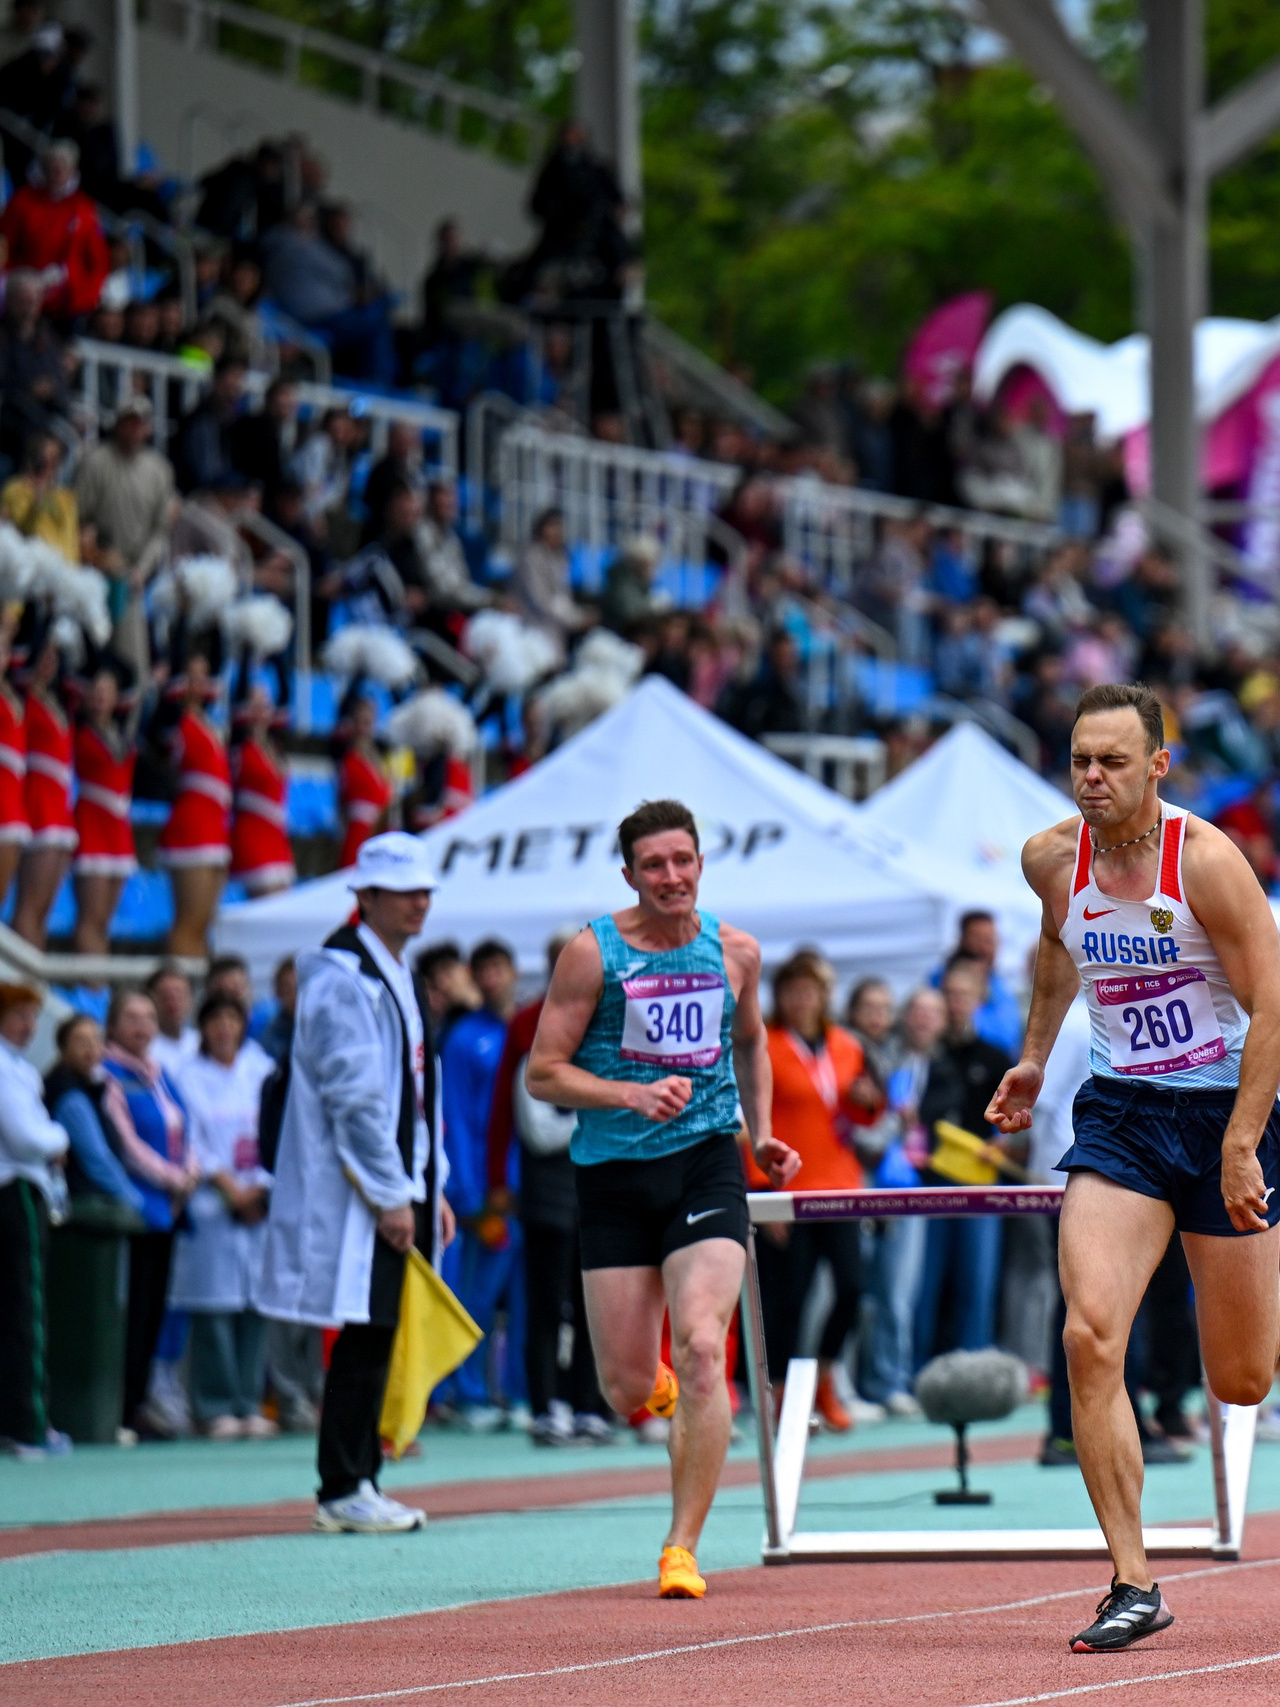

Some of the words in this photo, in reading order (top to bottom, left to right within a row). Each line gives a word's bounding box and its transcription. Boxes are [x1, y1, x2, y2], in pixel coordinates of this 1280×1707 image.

[1082, 931, 1180, 965] RUSSIA
[1100, 984, 1129, 993] FONBET
[1144, 980, 1161, 988] ПСБ
[646, 1001, 703, 1043] 340
[1122, 998, 1194, 1051] 260
[1188, 1045, 1219, 1061] FONBET
[802, 1200, 855, 1212] FONBET
